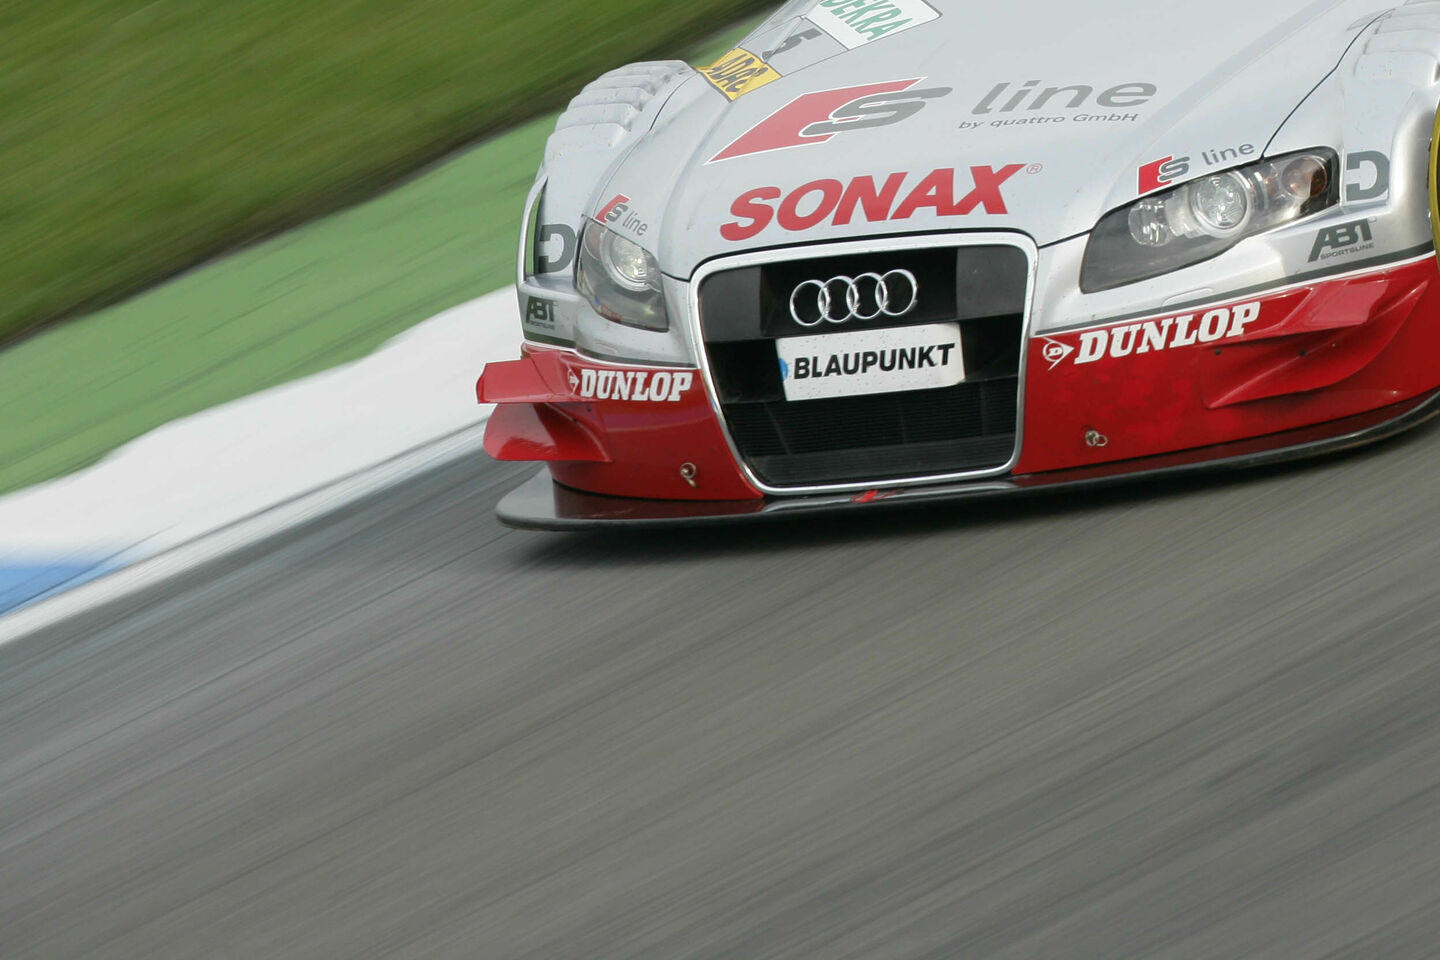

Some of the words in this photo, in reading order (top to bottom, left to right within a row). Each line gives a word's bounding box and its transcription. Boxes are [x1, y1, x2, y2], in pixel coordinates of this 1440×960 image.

[971, 79, 1157, 115] line
[958, 120, 985, 130] by
[989, 115, 1066, 128] quattro
[1072, 112, 1139, 123] GmbH
[1202, 143, 1256, 166] line
[622, 210, 648, 237] line
[1074, 301, 1262, 365] DUNLOP
[793, 343, 956, 380] BLAUPUNKT
[580, 369, 693, 402] DUNLOP
